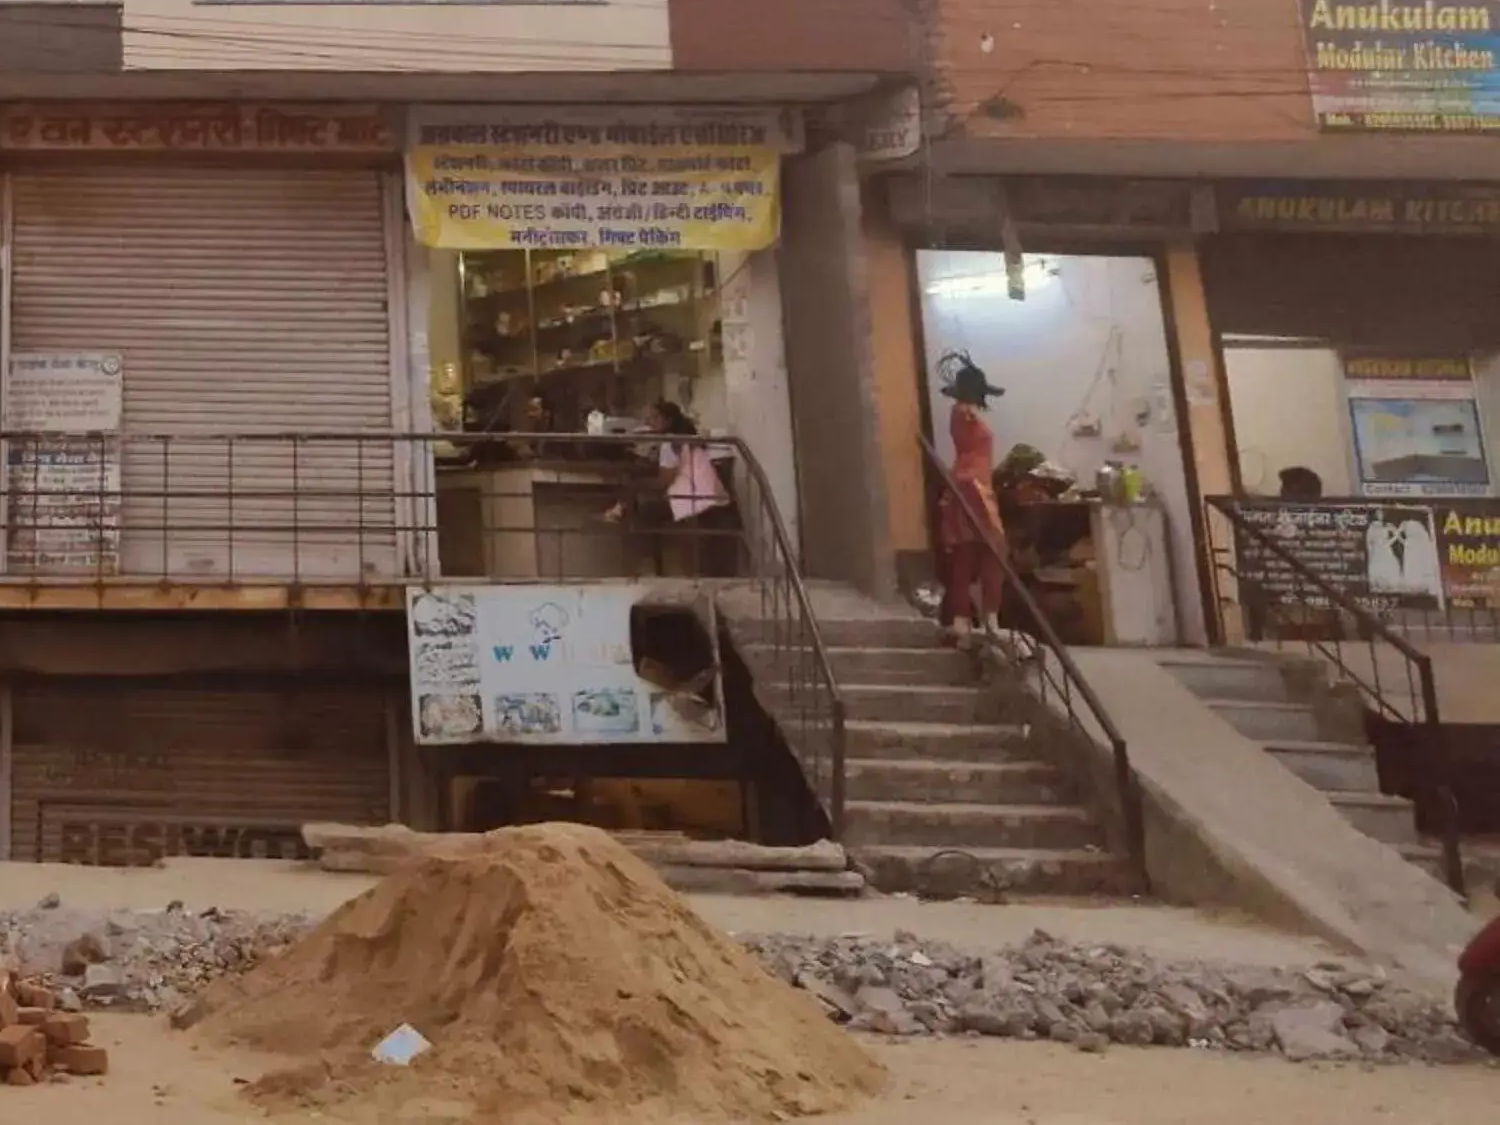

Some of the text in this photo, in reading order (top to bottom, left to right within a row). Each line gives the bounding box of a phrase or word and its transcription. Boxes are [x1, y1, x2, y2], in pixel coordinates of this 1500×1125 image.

[1317, 40, 1493, 70] Modular Kitchen
[449, 204, 481, 220] PDF
[487, 204, 547, 221] NOTES
